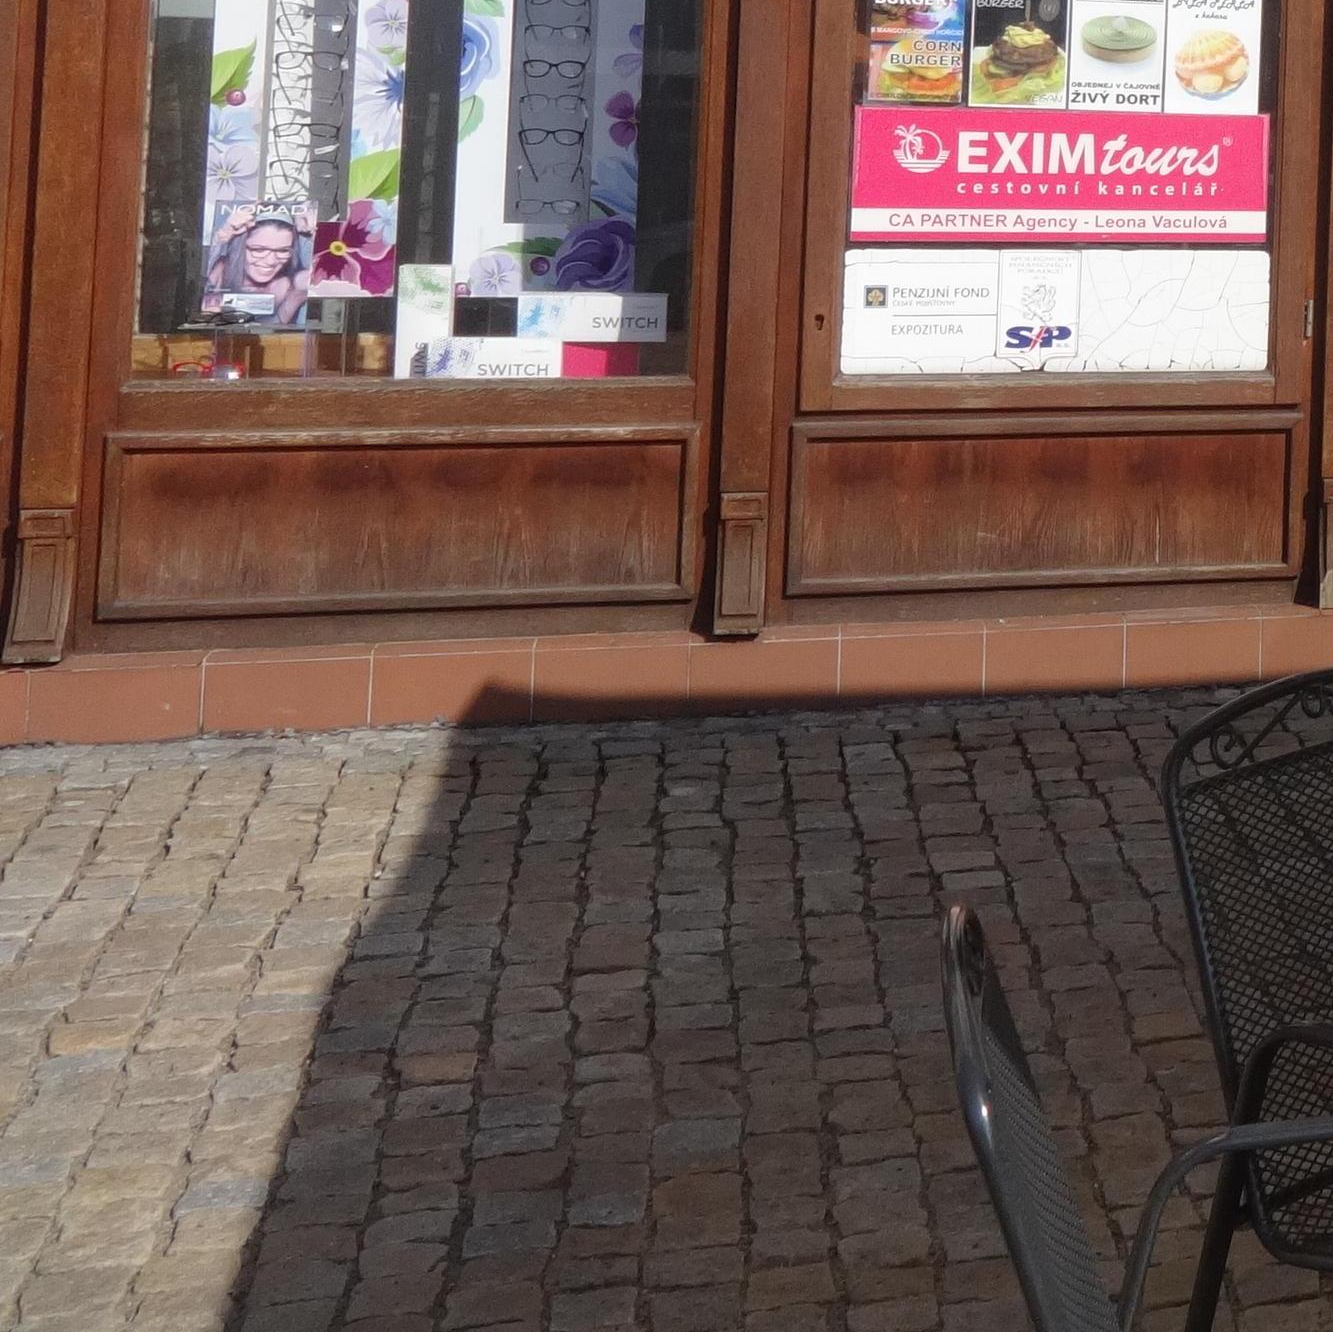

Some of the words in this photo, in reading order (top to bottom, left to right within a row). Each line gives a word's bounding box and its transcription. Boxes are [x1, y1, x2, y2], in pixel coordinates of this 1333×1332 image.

[913, 40, 961, 52] CORN
[890, 54, 961, 67] BURGER
[1071, 90, 1112, 104] ŽIVÝ
[1116, 94, 1160, 105] DORT
[957, 181, 1081, 195] cestovní
[1099, 181, 1219, 196] kancelář
[221, 204, 308, 216] NOMAD
[889, 213, 914, 227] CA
[921, 213, 1007, 228] PARTNER
[1014, 214, 1077, 232] Agency
[1095, 215, 1147, 229] Leona
[1152, 214, 1227, 229] Vaculová
[893, 285, 950, 298] PENZIJNÍ
[954, 287, 990, 298] FOND
[592, 317, 658, 329] SWITCH
[891, 324, 963, 335] EXPOZITURA
[477, 363, 549, 377] SWITCH
